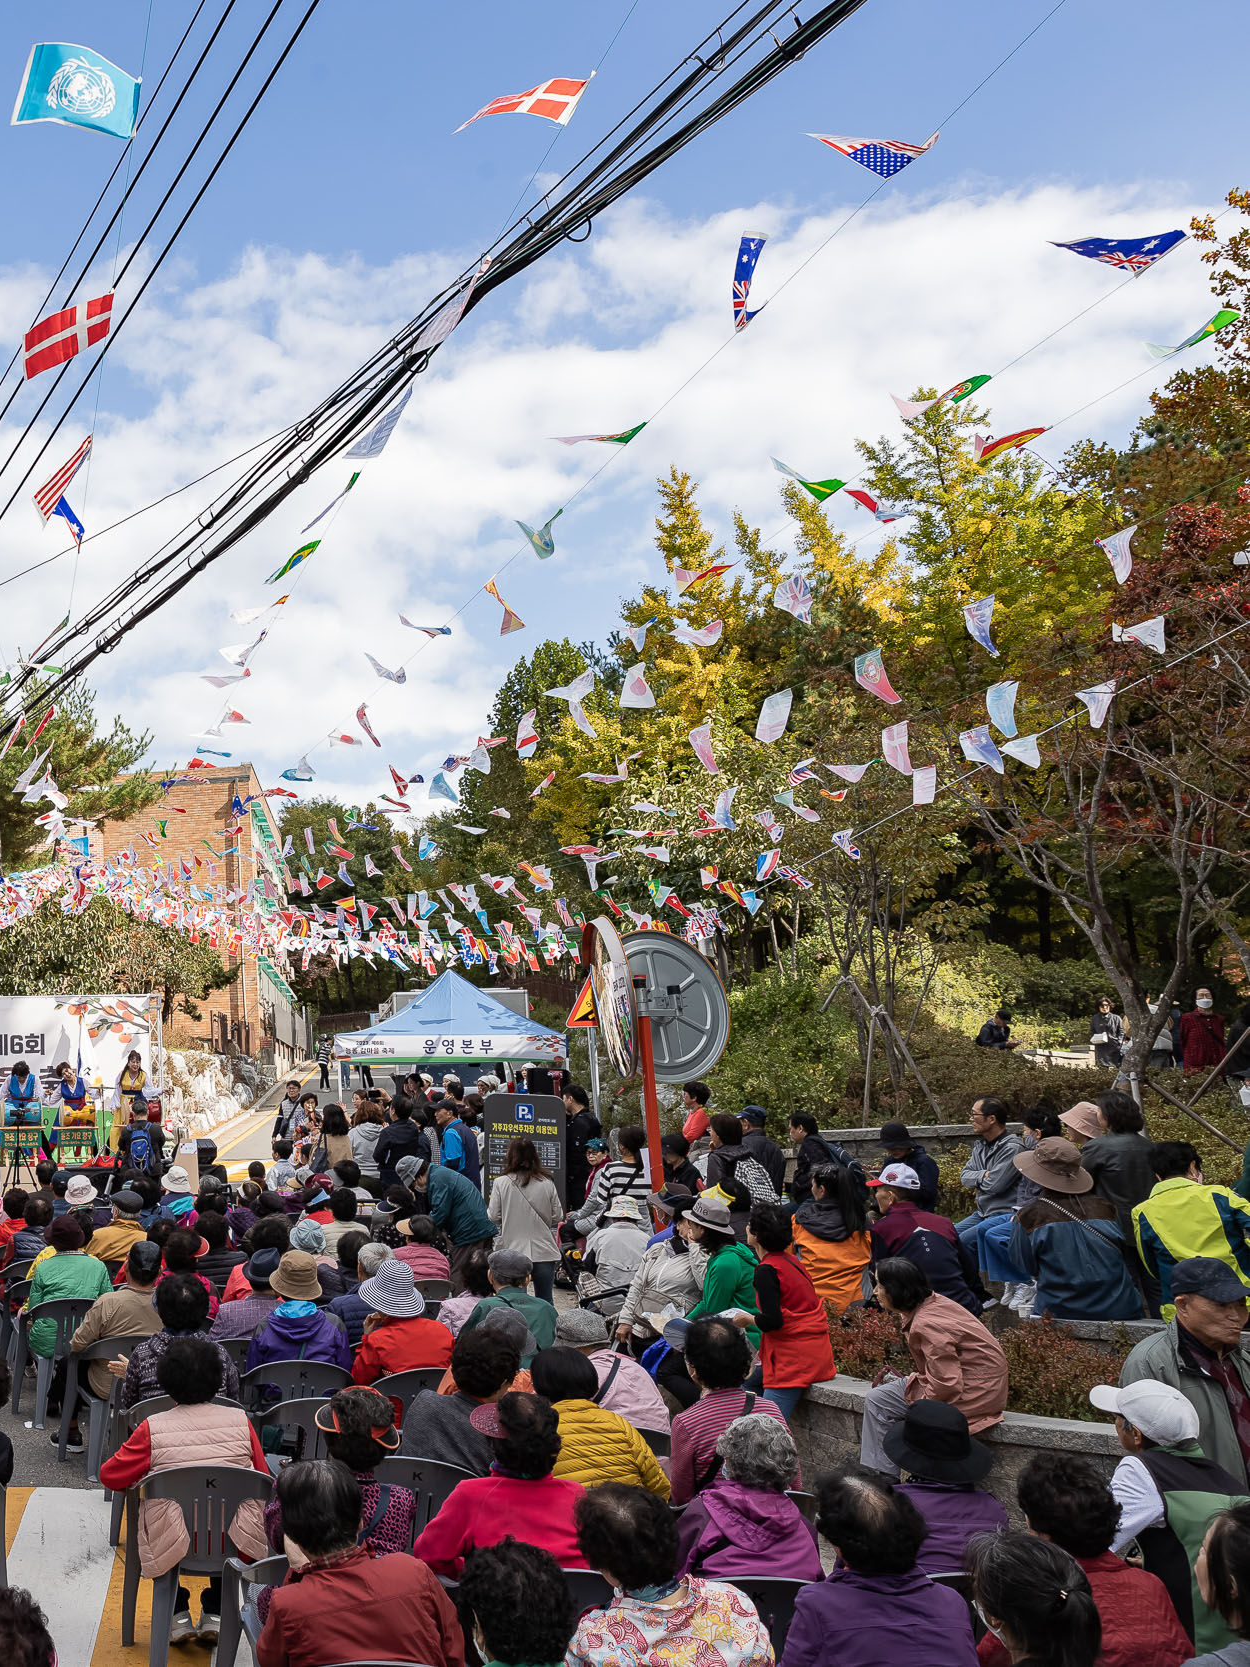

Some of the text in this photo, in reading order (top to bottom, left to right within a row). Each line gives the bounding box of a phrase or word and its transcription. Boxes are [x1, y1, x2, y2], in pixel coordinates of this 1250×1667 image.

[381, 1047, 395, 1055] 축제
[422, 1039, 494, 1055] 운영본부
[492, 1122, 558, 1135] 거주자우선주차장 이용안내
[300, 1371, 308, 1379] K
[420, 1379, 427, 1387] K
[412, 1471, 423, 1481] K
[206, 1478, 217, 1488] K
